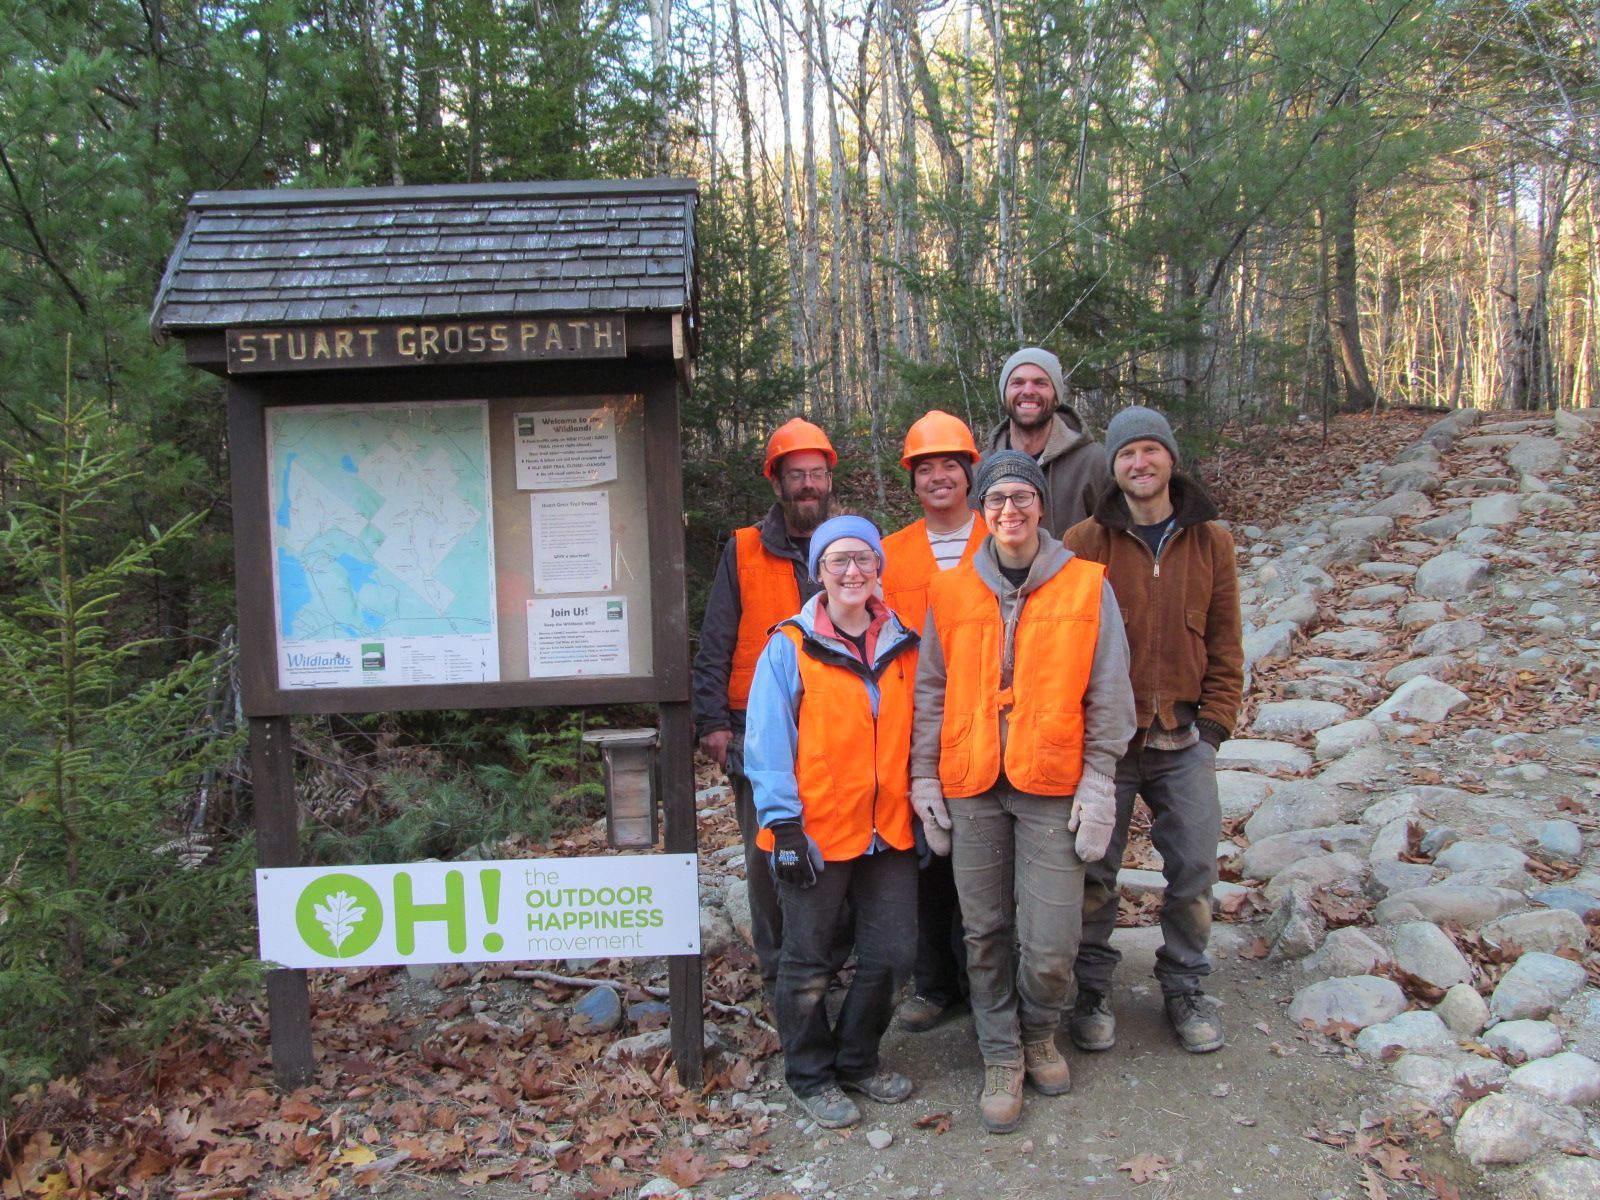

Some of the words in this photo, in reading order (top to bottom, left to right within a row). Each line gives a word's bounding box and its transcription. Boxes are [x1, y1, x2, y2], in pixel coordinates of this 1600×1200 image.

[238, 328, 378, 362] STUART
[396, 326, 509, 355] GROSS
[519, 321, 613, 351] PATH
[542, 417, 577, 425] Welcome
[553, 425, 592, 433] Wildlands
[550, 608, 570, 618] Join
[573, 607, 589, 617] Us!
[287, 653, 351, 667] Wildlands
[524, 868, 559, 886] the
[525, 886, 653, 909] OUTDOOR
[295, 868, 504, 958] OH!
[527, 908, 664, 932] HAPPINESS
[528, 932, 644, 953] movement
